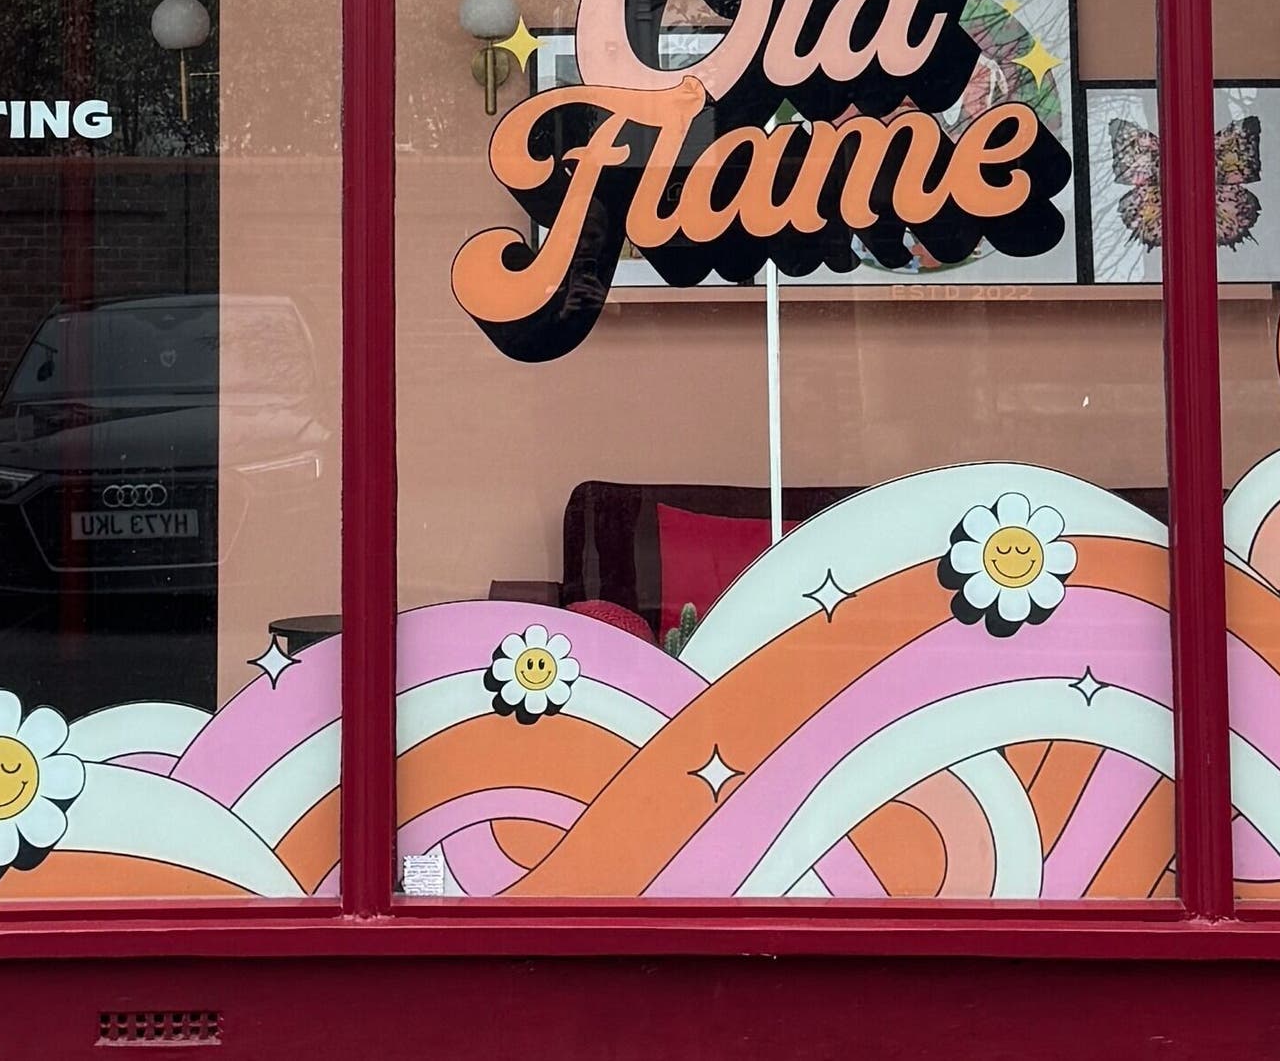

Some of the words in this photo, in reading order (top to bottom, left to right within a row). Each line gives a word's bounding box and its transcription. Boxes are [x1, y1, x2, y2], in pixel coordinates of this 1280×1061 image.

[451, 75, 1040, 324] Flame
[892, 284, 960, 300] ESTD
[970, 285, 1034, 300] 2022
